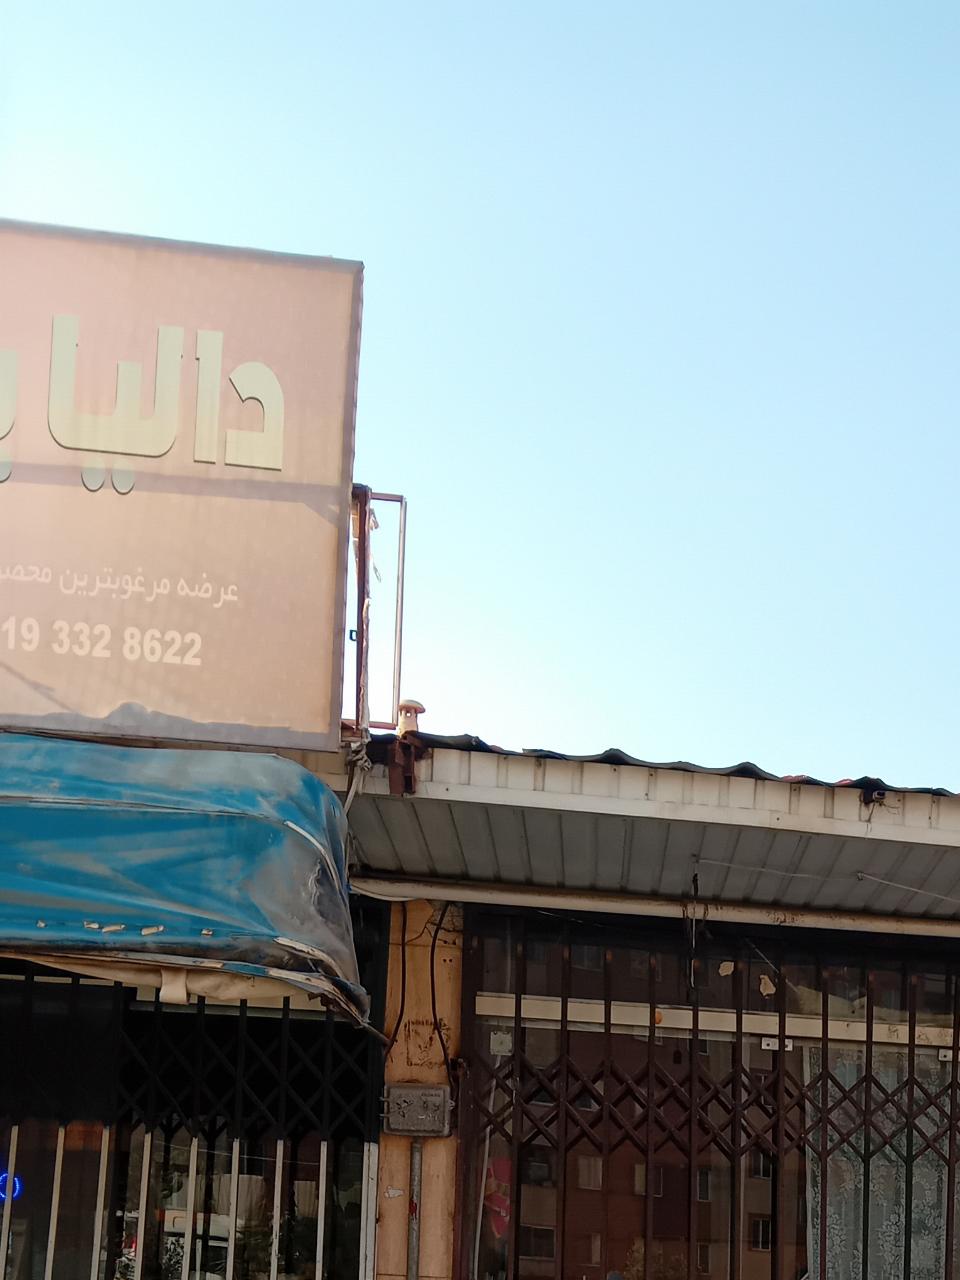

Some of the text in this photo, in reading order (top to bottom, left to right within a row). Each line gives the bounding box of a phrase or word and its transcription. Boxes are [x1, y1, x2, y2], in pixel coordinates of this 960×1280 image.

[47, 314, 285, 495] دالیا
[177, 572, 239, 608] عرضه
[51, 619, 112, 659] 332
[122, 626, 203, 666] 8622
